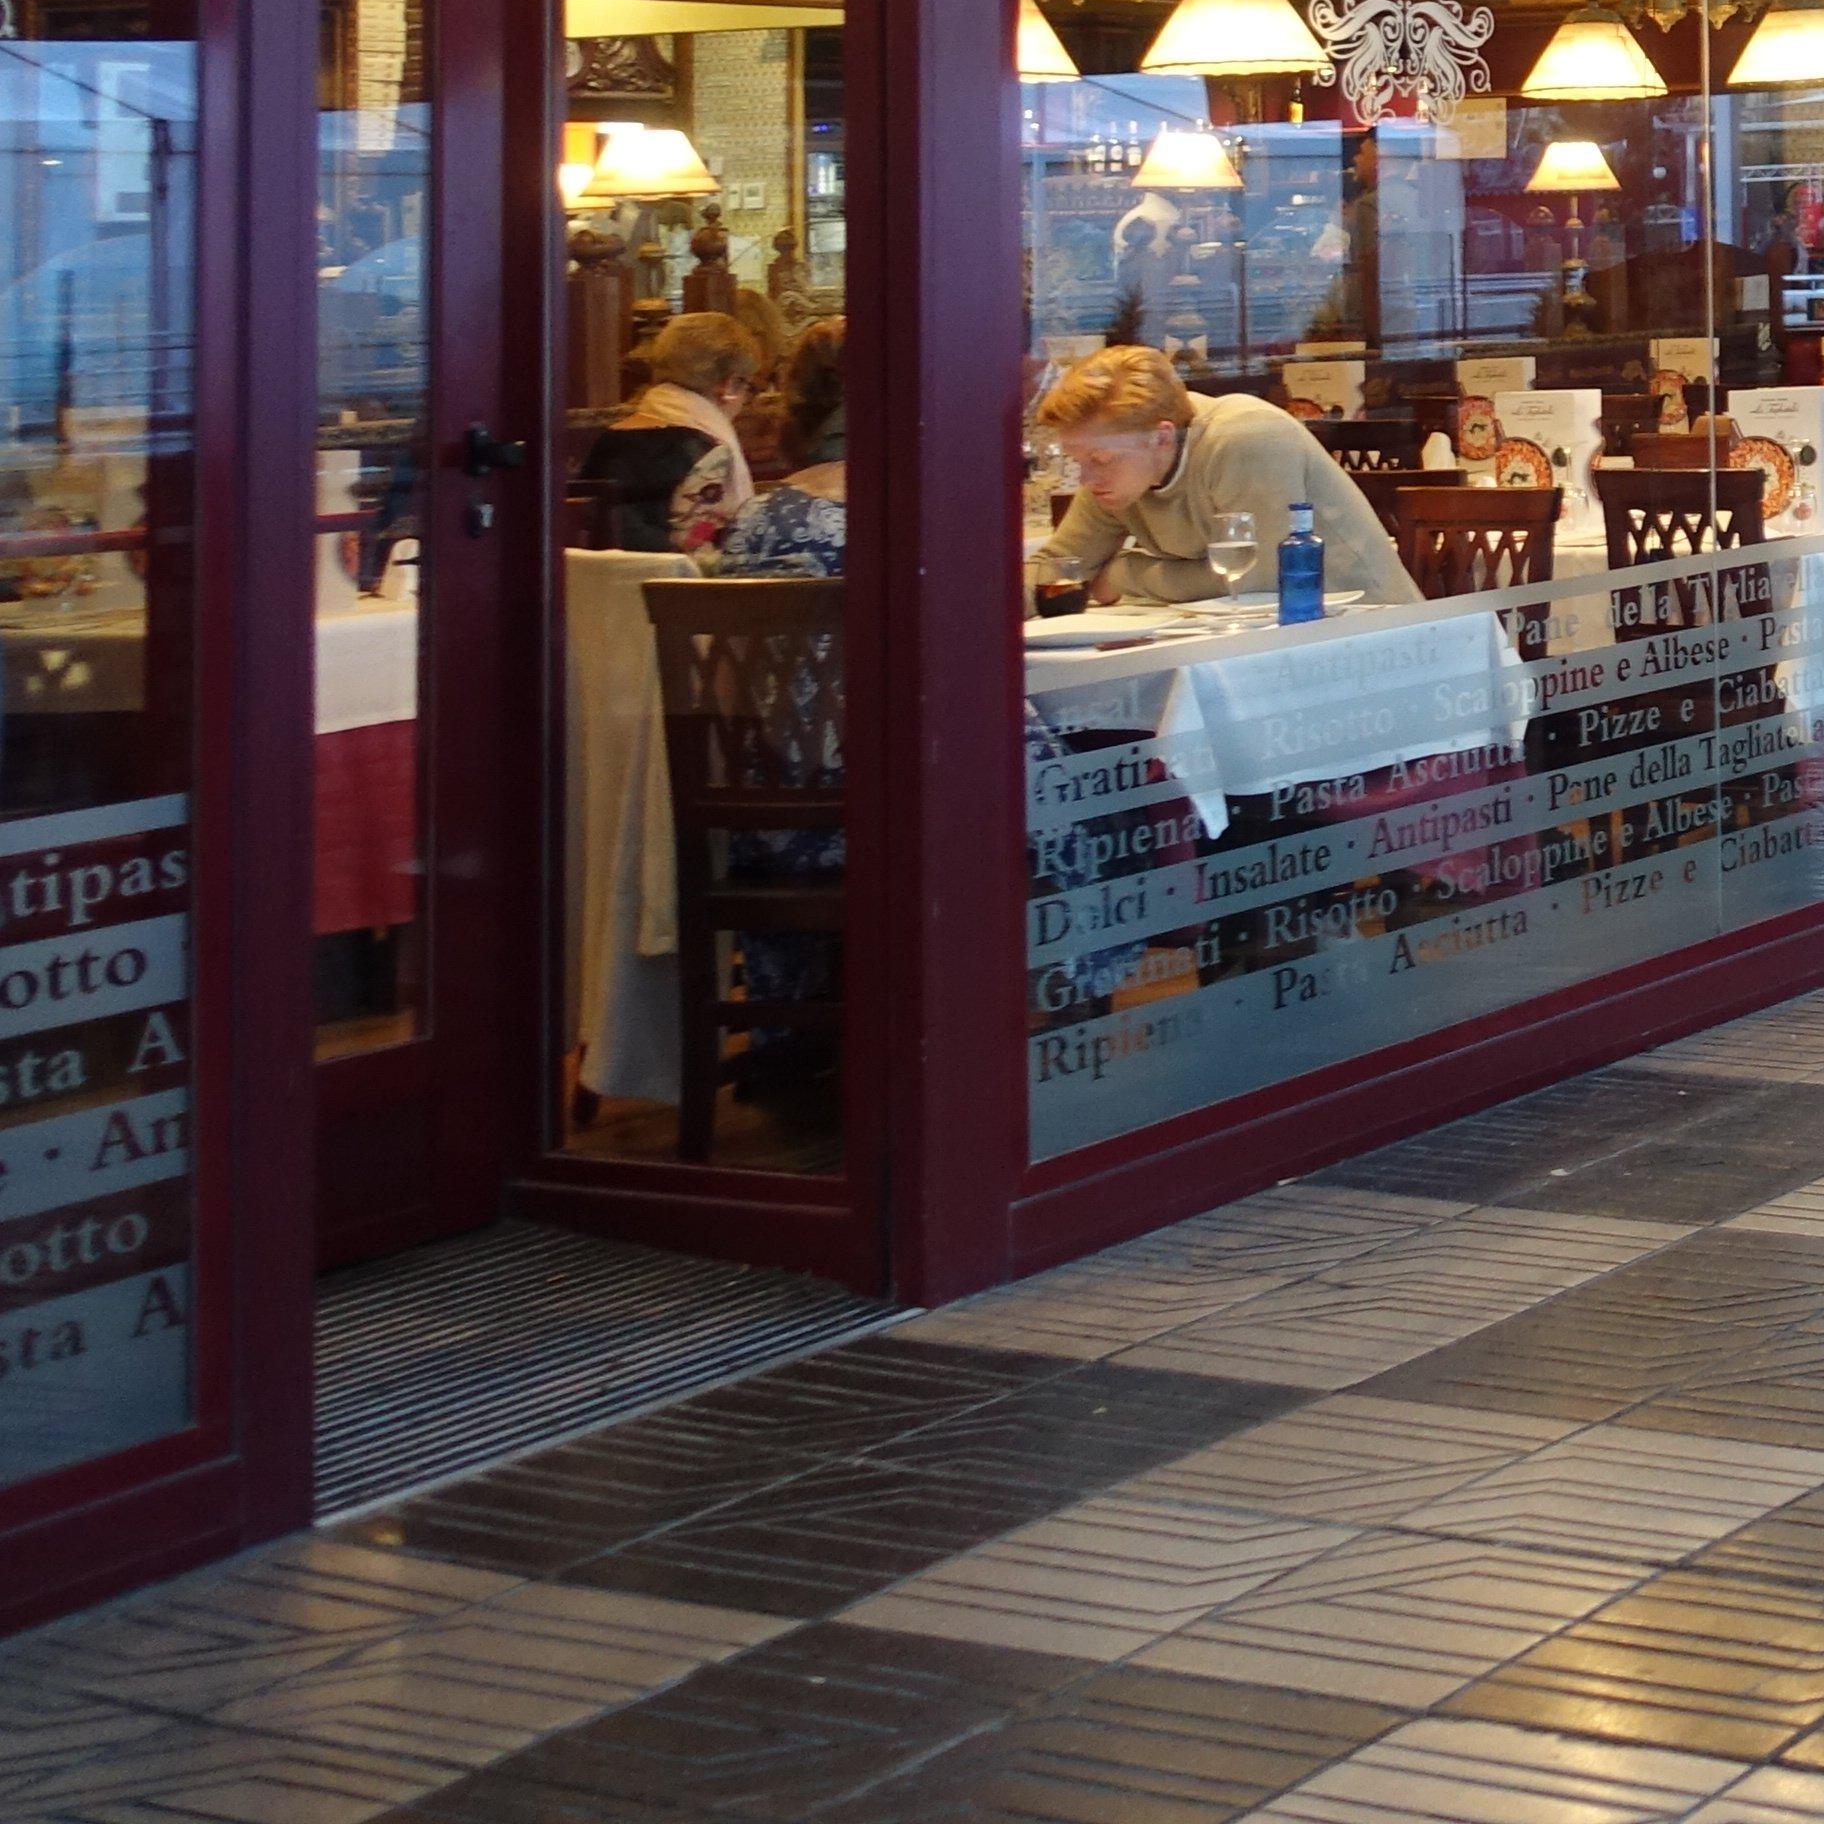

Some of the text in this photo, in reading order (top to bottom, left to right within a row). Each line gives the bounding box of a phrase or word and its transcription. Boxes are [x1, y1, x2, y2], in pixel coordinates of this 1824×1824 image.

[1433, 655, 1604, 724] Scaoppine
[1615, 655, 1632, 684] e
[1638, 631, 1732, 680] Albese
[1268, 770, 1369, 823] Pasta
[1577, 702, 1662, 750] Pizze
[1680, 692, 1696, 723] e
[1192, 840, 1332, 906] Insalate
[1367, 783, 1514, 861] Antipasti
[1547, 770, 1615, 814] Pane
[1628, 743, 1693, 792] della
[1264, 887, 1398, 952] Risotto
[1435, 824, 1607, 904] Scaloppine
[1619, 818, 1636, 850] e
[1641, 793, 1733, 843] Albese
[1581, 867, 1664, 918] Pizze
[1682, 853, 1698, 886] e
[0, 944, 148, 1010] otto
[128, 1010, 187, 1074] A
[0, 1208, 149, 1281] otto
